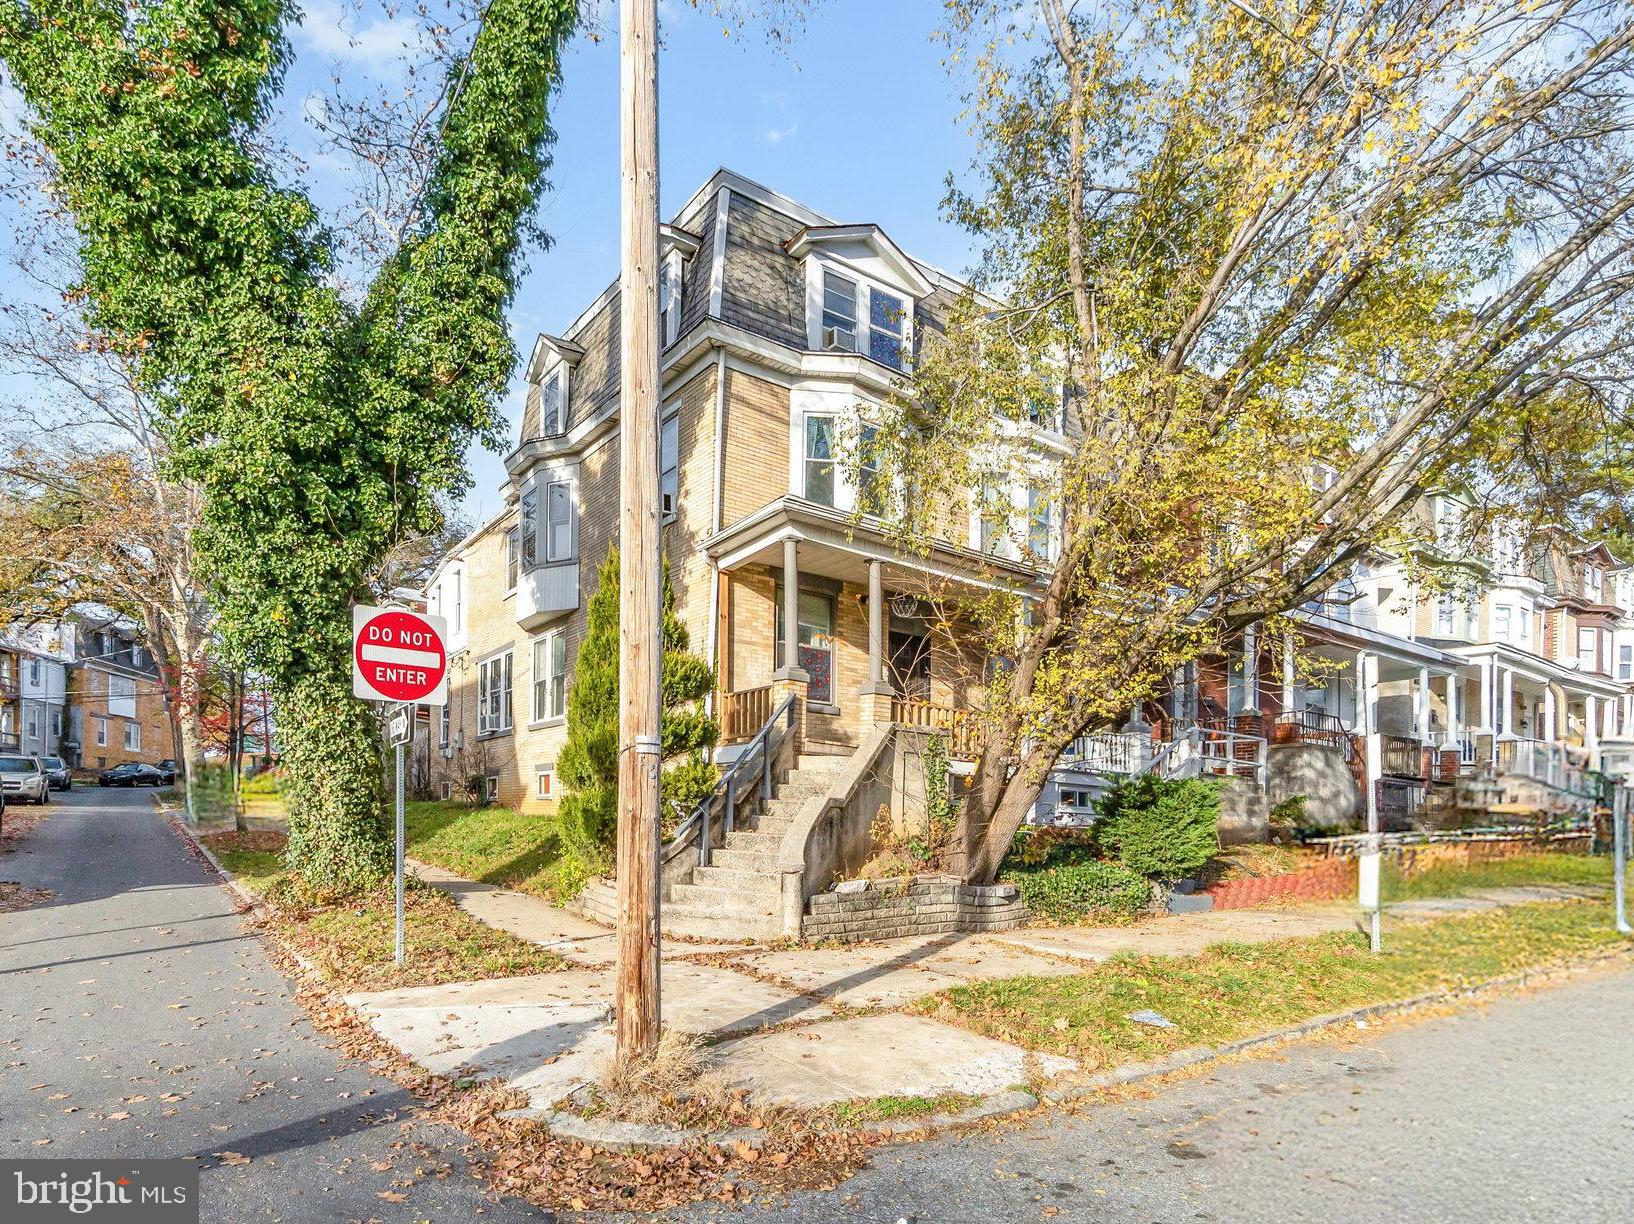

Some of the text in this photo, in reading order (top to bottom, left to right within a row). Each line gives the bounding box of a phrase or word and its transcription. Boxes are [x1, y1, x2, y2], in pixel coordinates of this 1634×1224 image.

[369, 626, 433, 647] DO NOT
[375, 666, 427, 686] ENTER
